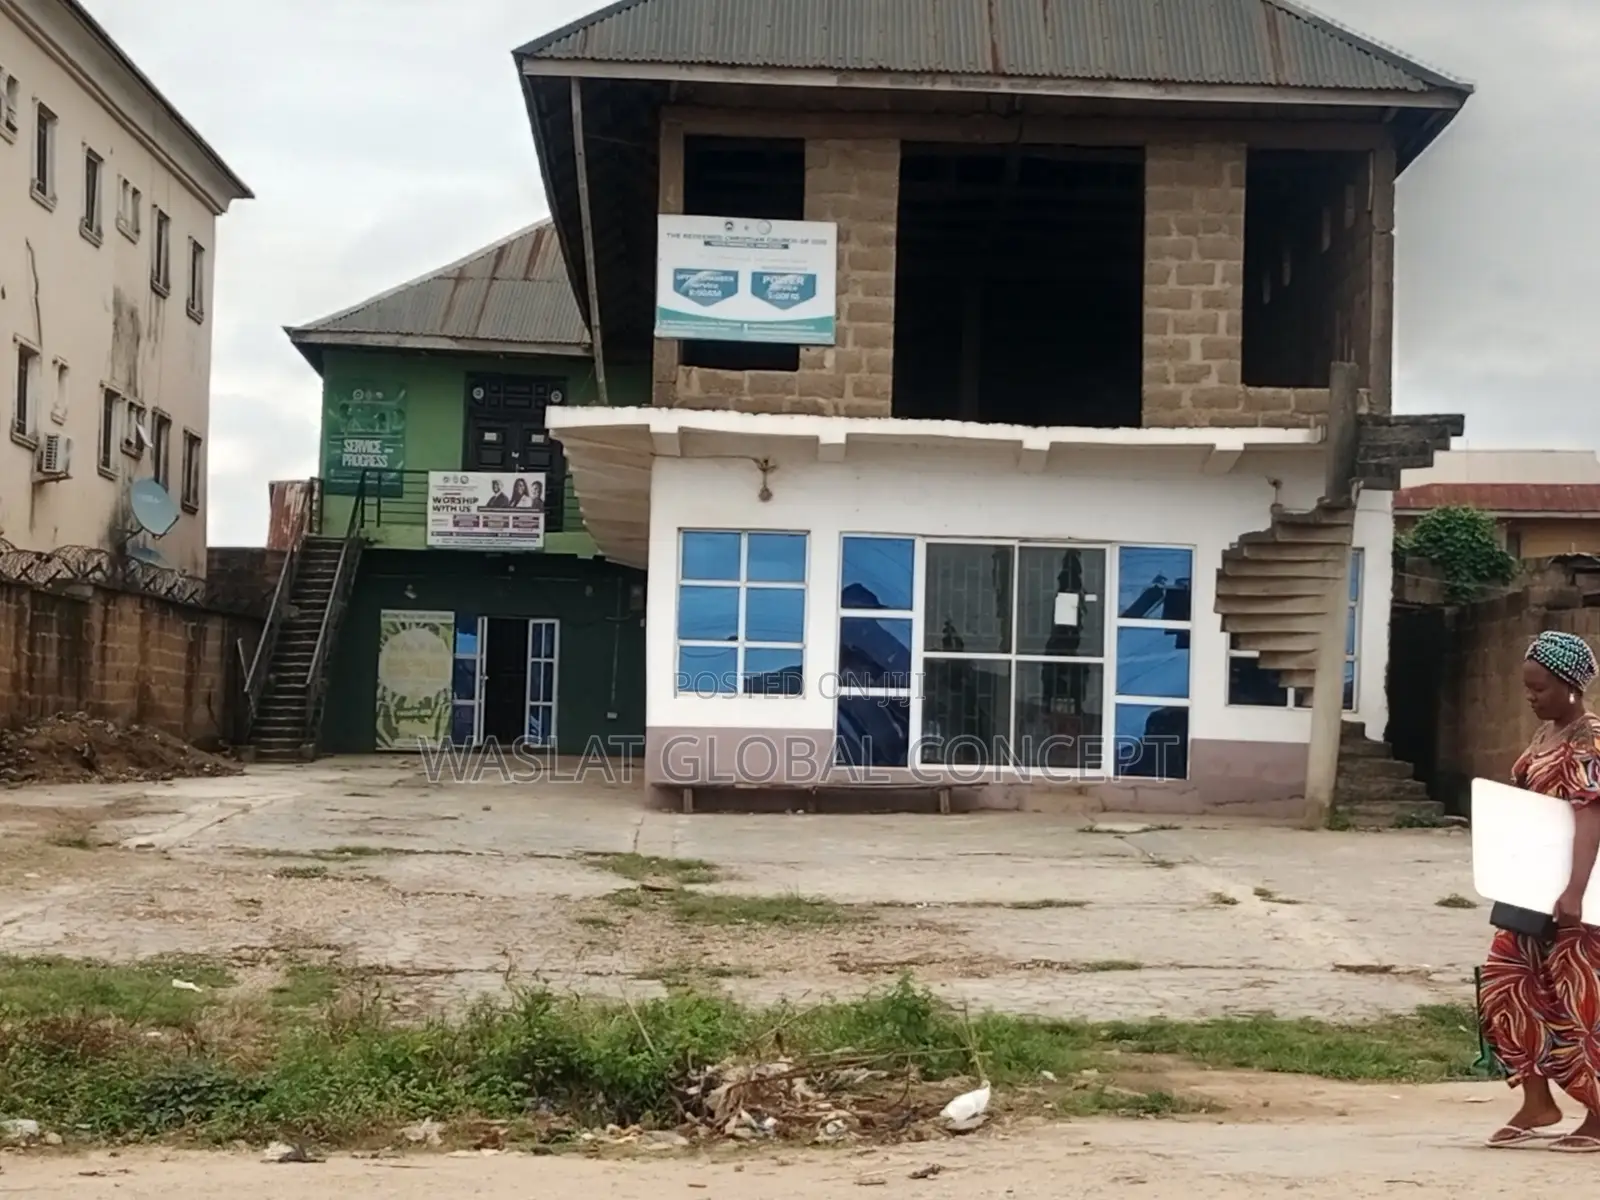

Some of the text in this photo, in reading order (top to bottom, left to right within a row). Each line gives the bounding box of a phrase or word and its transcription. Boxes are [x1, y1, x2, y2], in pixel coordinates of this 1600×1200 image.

[343, 439, 383, 453] SERVICE
[342, 453, 389, 468] PROGRESS
[432, 496, 479, 505] WORSHIP
[459, 505, 471, 513] US
